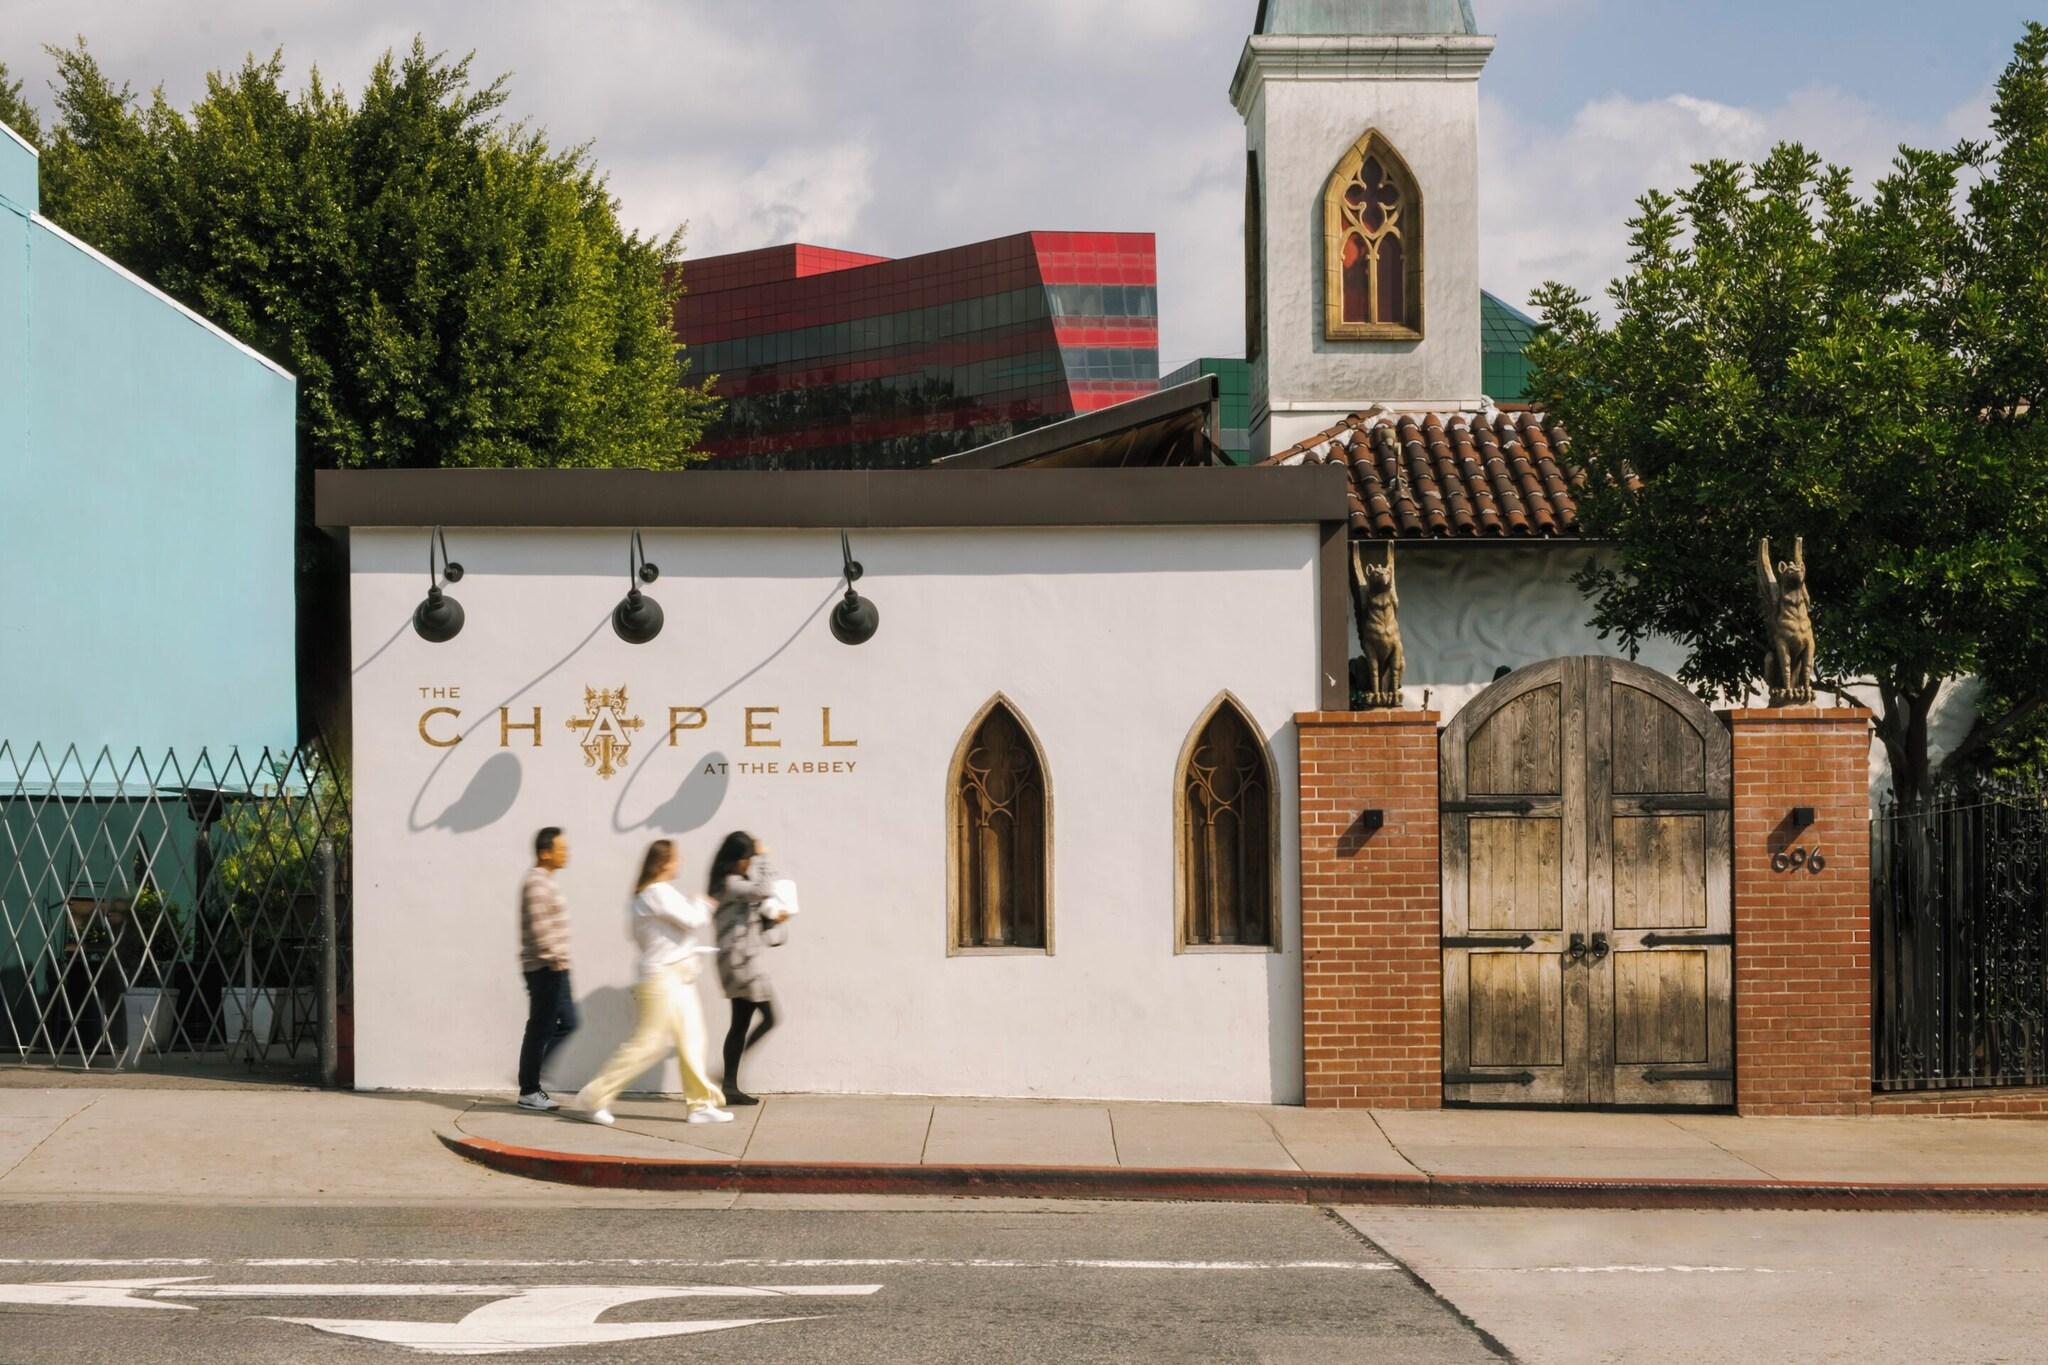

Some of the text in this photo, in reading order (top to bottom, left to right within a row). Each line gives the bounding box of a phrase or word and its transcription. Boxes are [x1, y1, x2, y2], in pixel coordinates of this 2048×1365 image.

[419, 687, 460, 699] THE
[418, 705, 858, 748] CHAPEL
[703, 761, 858, 775] AT THE ABBEY
[1771, 846, 1826, 875] 696
